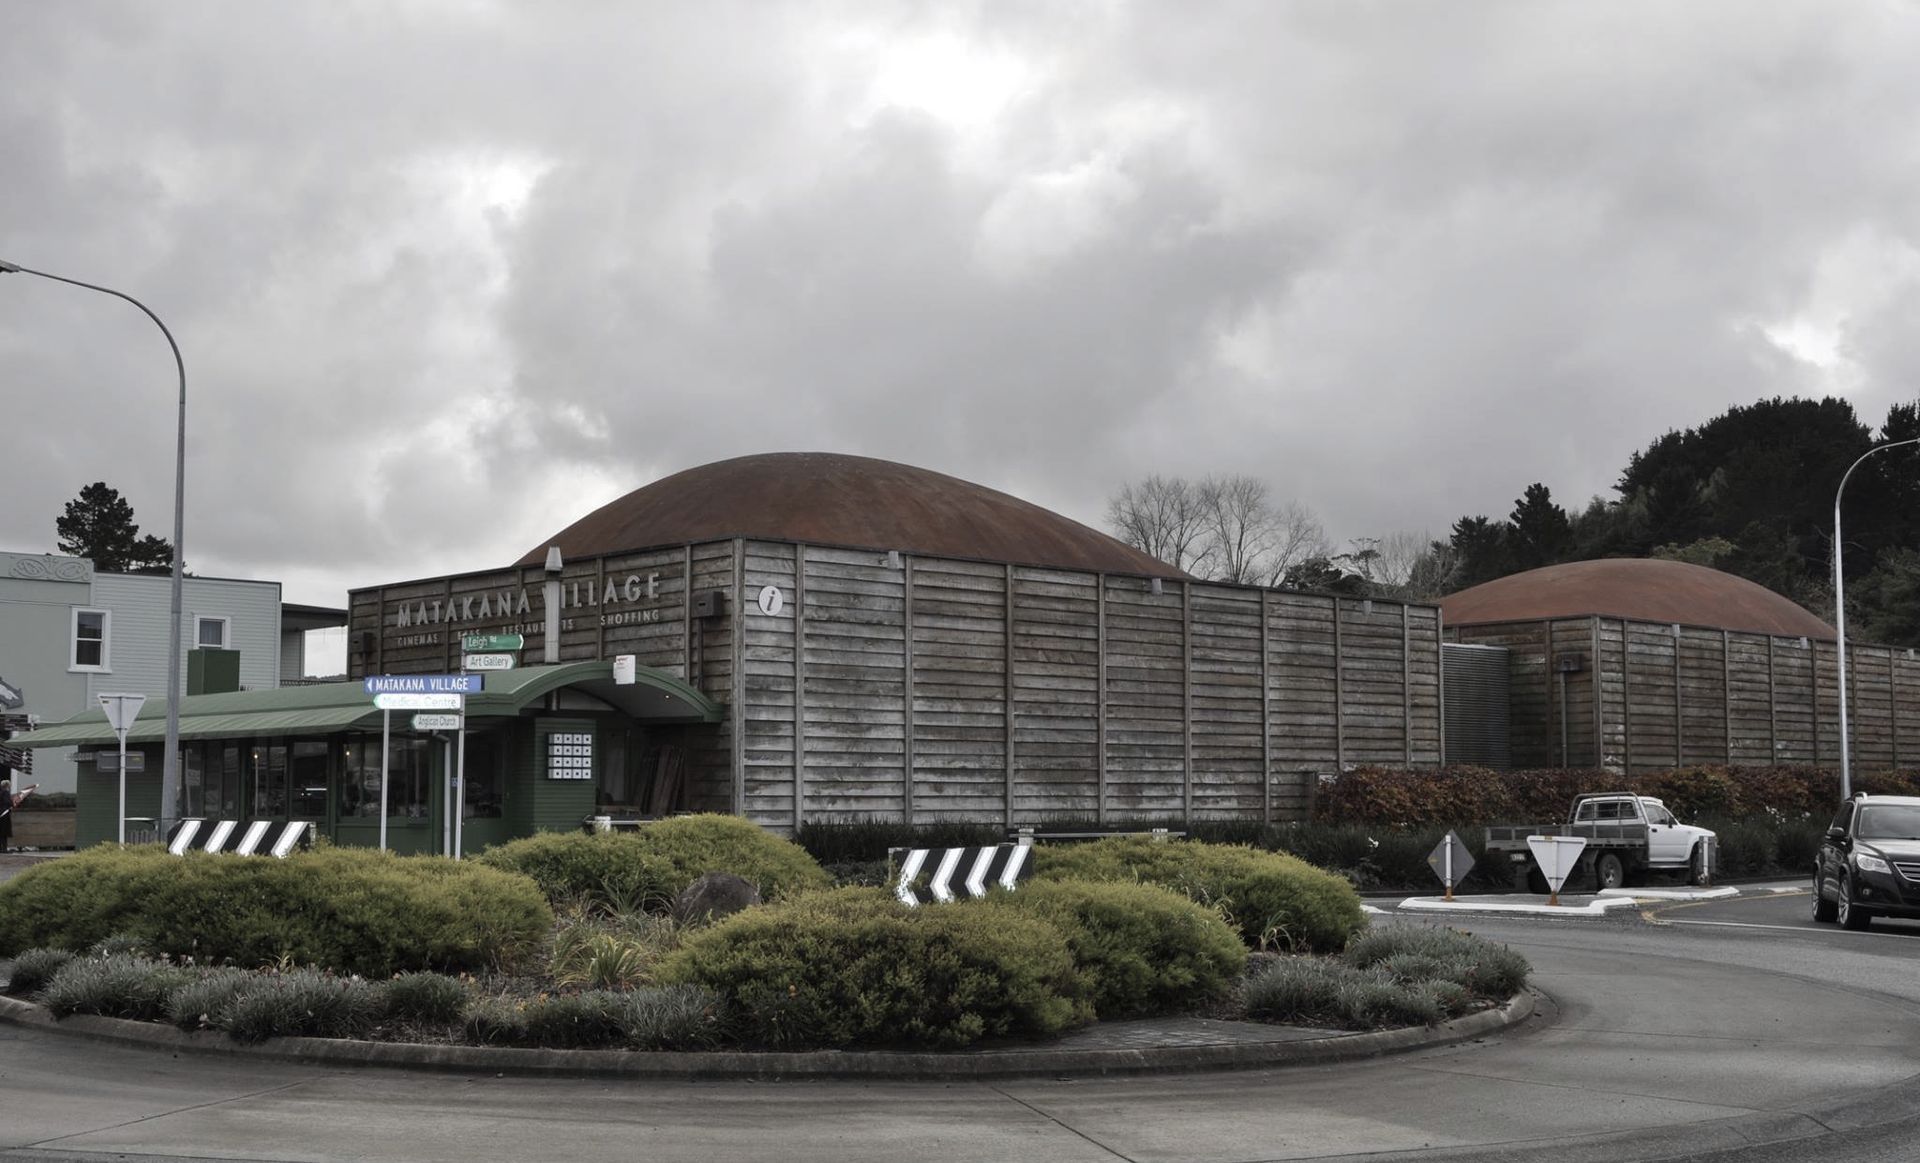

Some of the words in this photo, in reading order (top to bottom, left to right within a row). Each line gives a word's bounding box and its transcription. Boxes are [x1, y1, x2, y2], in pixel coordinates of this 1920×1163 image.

[397, 588, 531, 628] MATAKANA
[542, 572, 660, 610] ILLAGE
[397, 633, 439, 647] CINEMAS
[468, 636, 488, 649] Leigh
[470, 655, 482, 667] Art
[483, 655, 509, 668] Gallery
[376, 679, 425, 691] MATAKANA
[430, 678, 469, 691] VILLAGE
[424, 696, 457, 707] Centre
